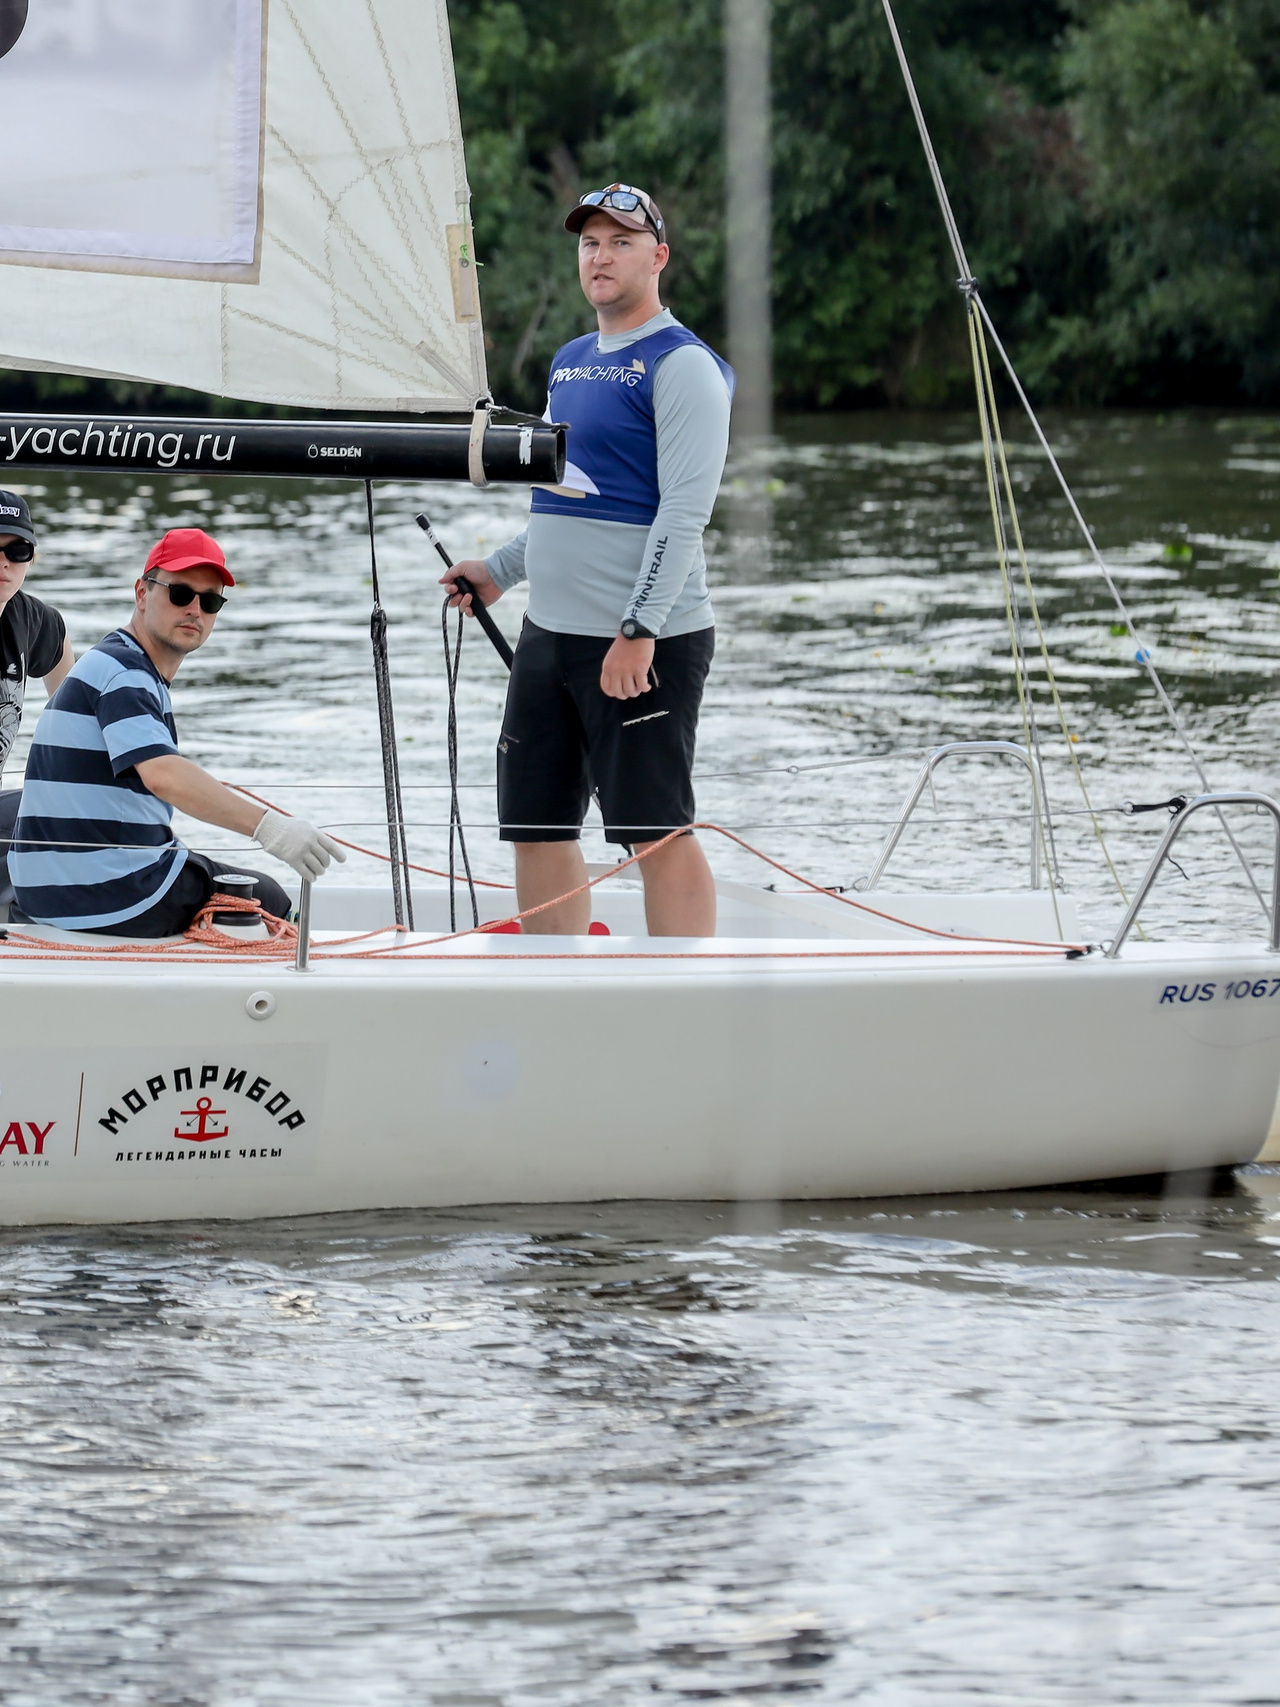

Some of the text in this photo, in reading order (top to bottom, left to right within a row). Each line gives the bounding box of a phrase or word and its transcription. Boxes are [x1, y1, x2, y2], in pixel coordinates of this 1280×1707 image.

[550, 365, 642, 388] PROYACHTING
[320, 445, 363, 459] SELDÉN
[1159, 983, 1217, 1004] RUS
[97, 1065, 307, 1136] МОРПРИБОР
[115, 1148, 283, 1162] ЛЕГЕНДАРНЫЕ ЧАСЫ
